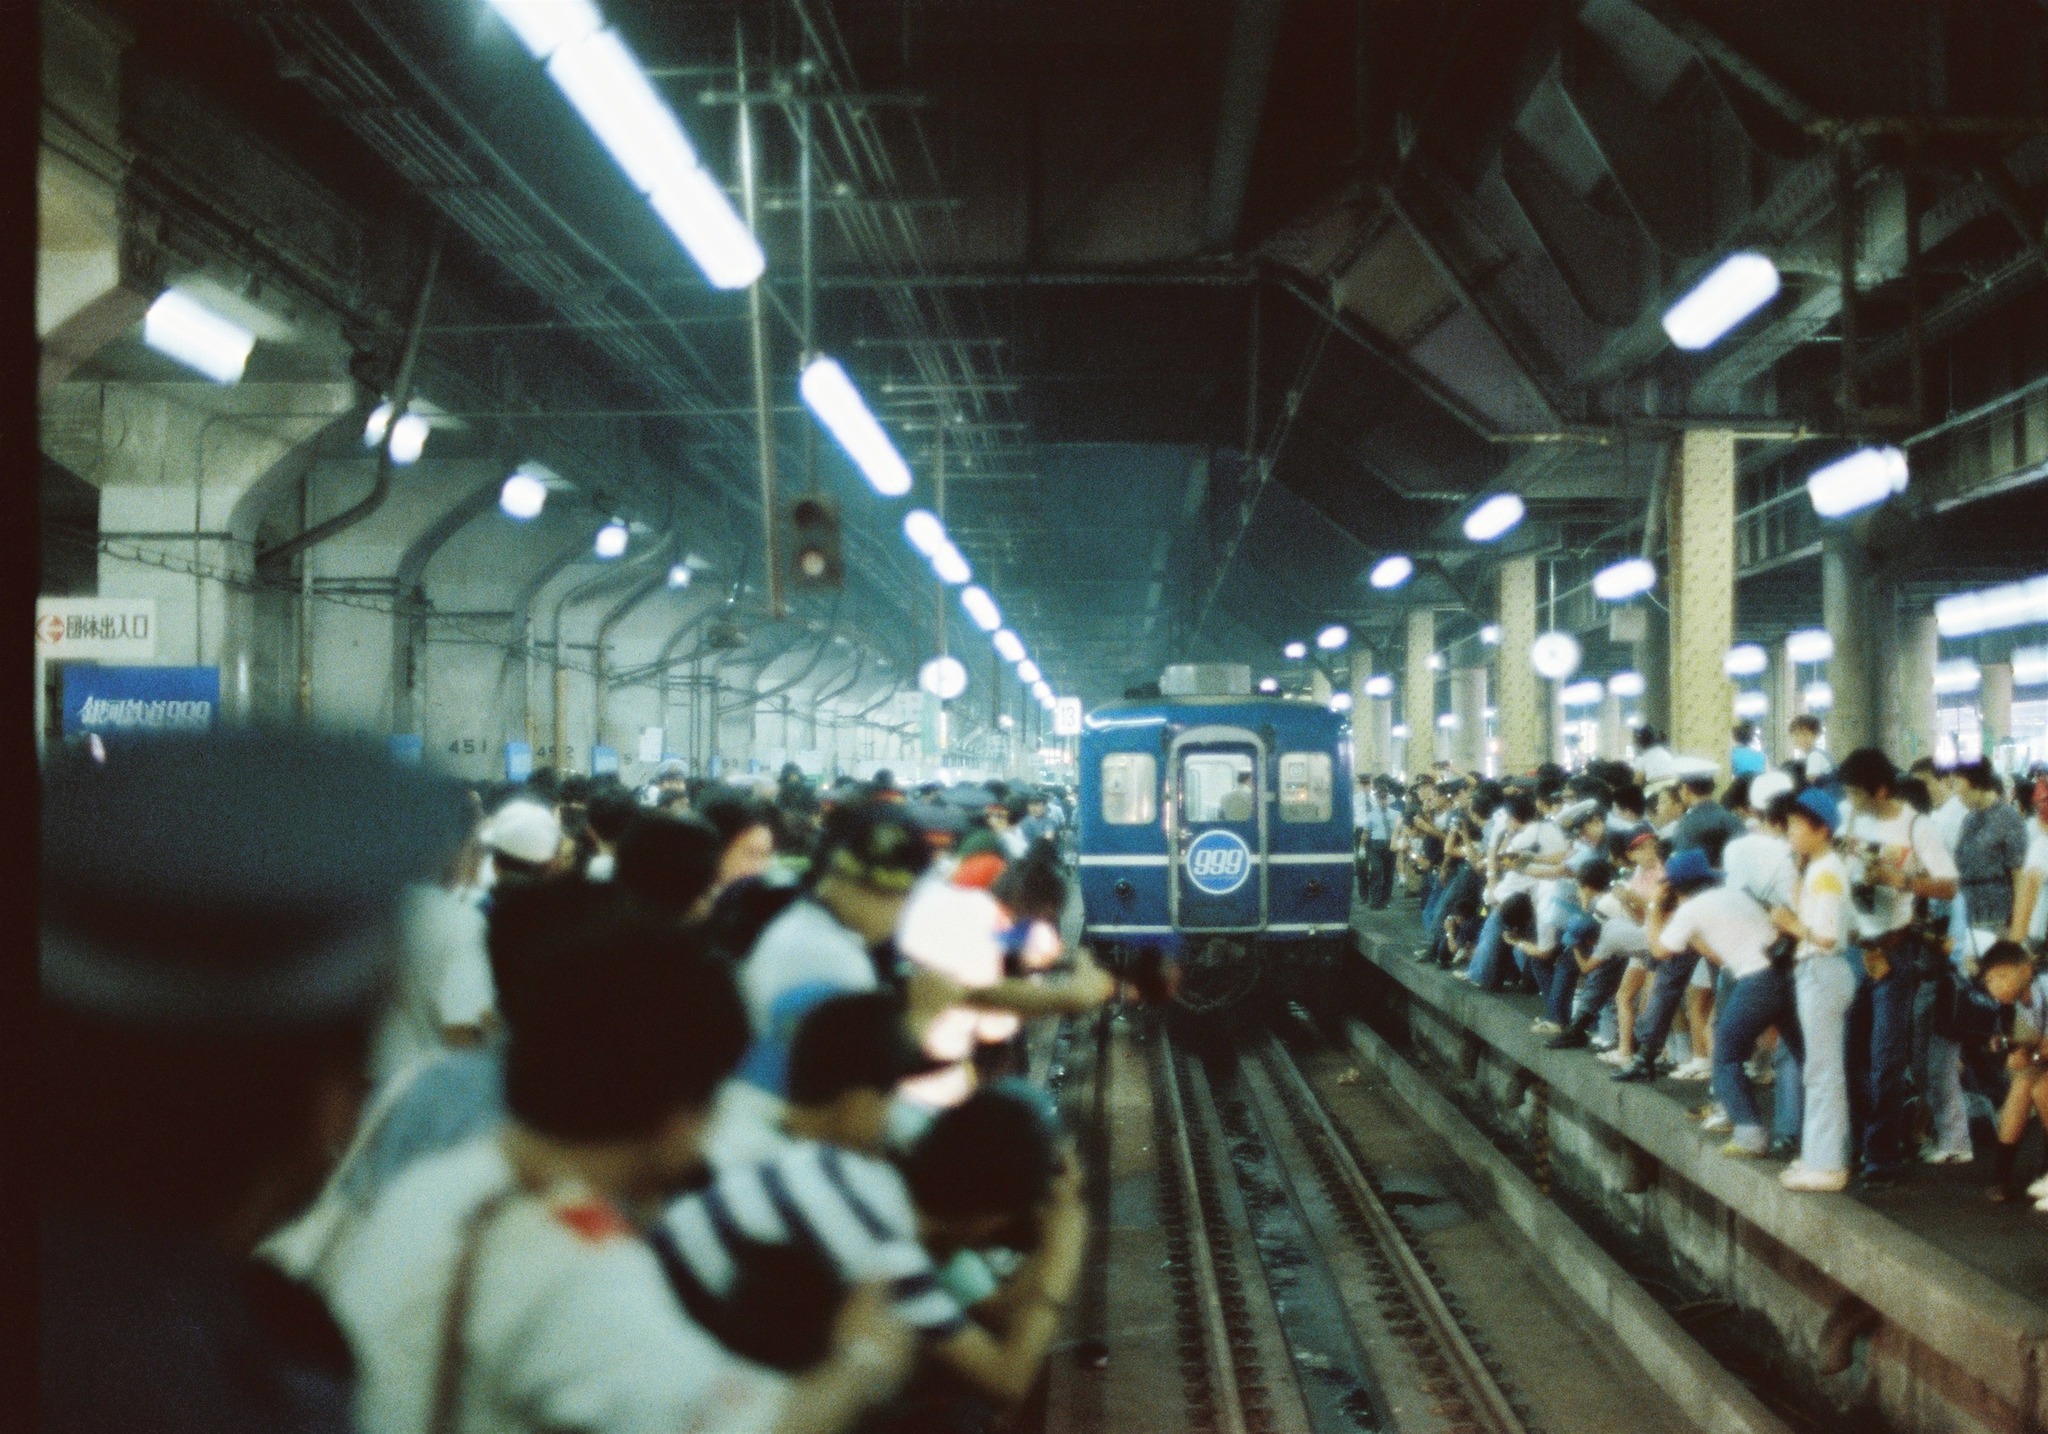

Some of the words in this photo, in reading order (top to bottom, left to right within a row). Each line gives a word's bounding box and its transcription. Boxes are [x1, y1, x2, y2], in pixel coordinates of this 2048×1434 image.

[66, 615, 148, 640] 団体出入口
[1062, 706, 1075, 727] 13
[1193, 849, 1243, 876] 999
